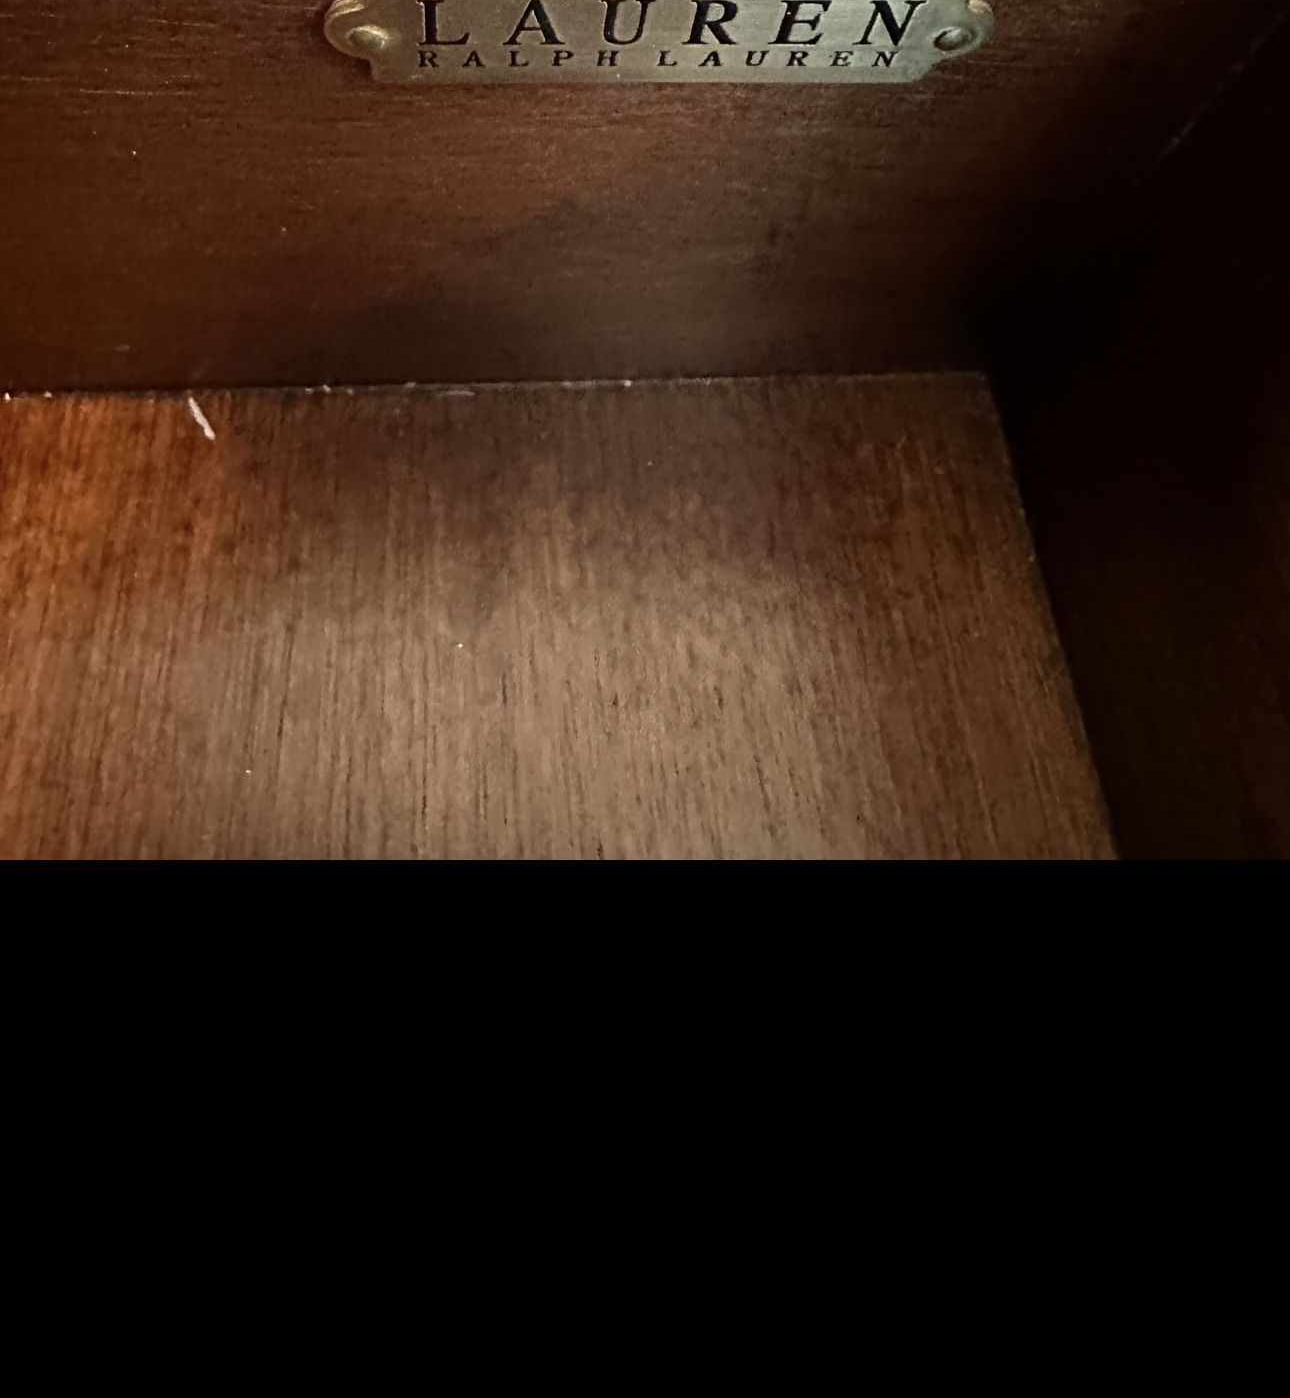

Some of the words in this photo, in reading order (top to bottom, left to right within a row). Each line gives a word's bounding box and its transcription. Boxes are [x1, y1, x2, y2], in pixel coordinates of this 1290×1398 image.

[418, 0, 927, 45] LAUREN
[418, 50, 620, 67] RALPH
[657, 50, 900, 68] LAUREN
